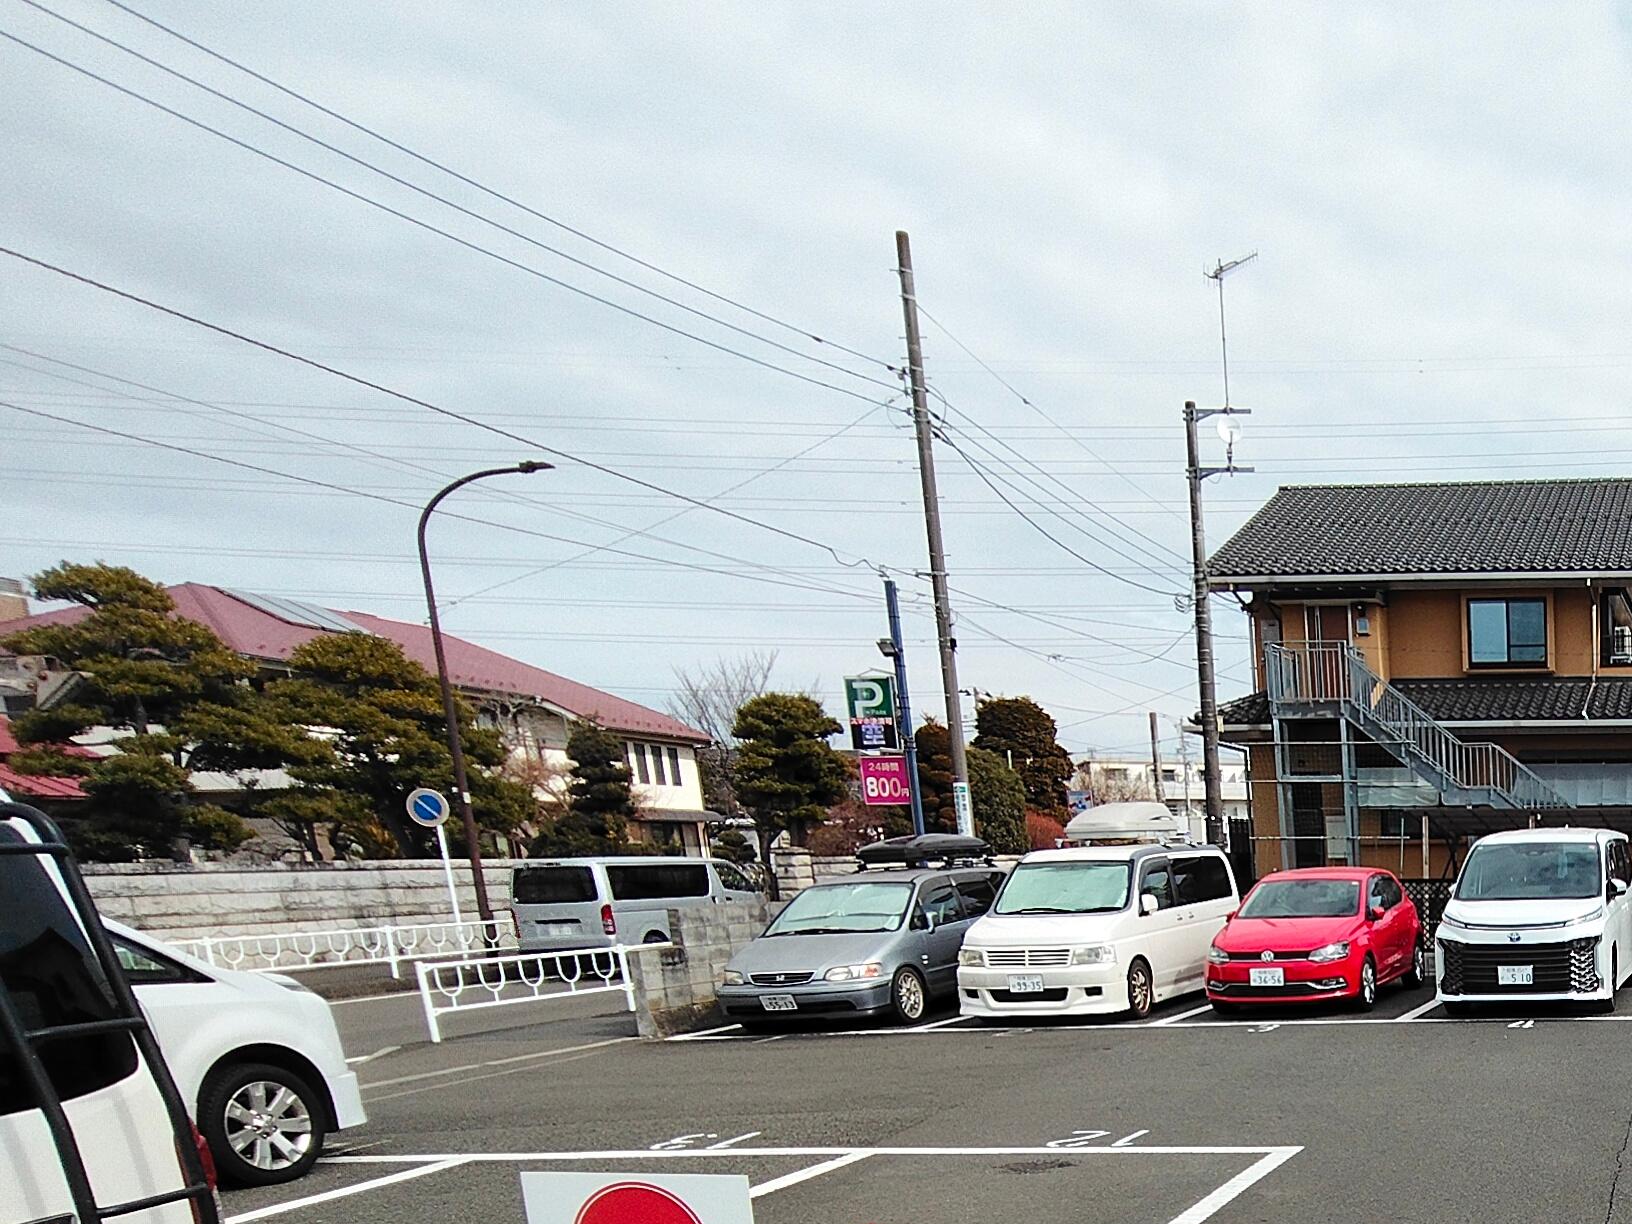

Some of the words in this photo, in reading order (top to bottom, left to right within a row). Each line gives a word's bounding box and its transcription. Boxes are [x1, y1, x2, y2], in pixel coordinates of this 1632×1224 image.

[852, 681, 883, 718] P
[866, 777, 909, 798] 800円
[648, 1131, 761, 1150] 13
[1046, 1129, 1150, 1148] 12
